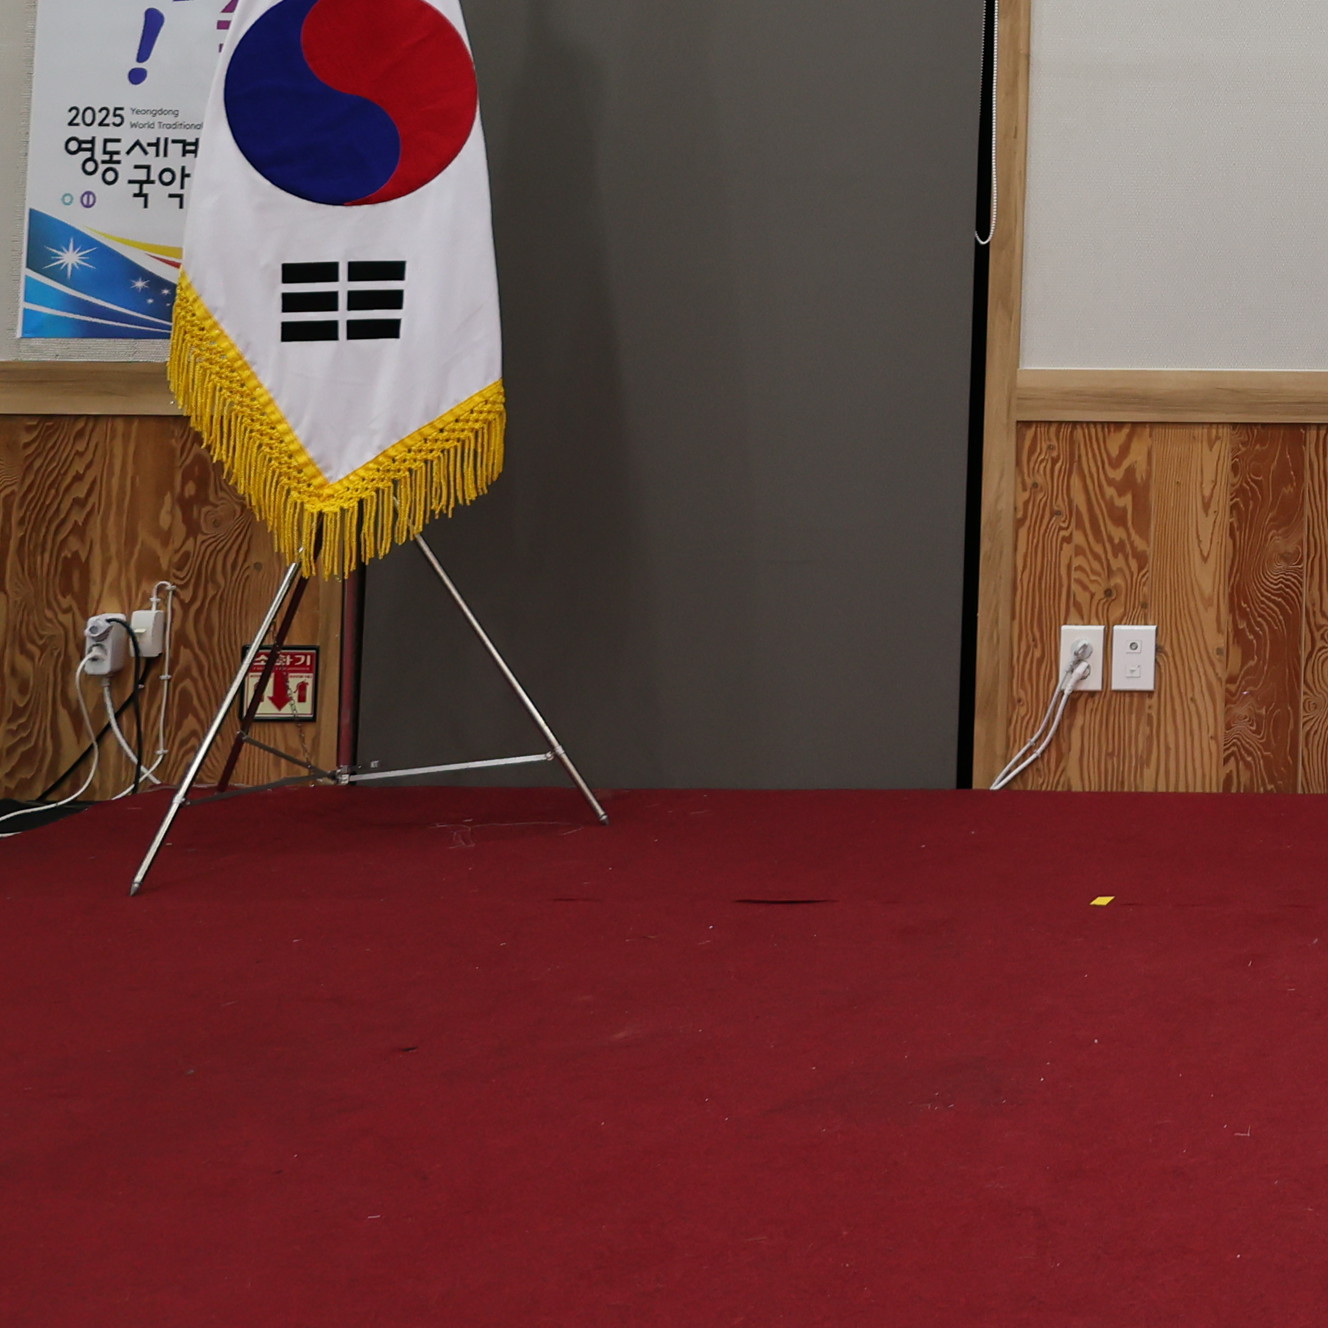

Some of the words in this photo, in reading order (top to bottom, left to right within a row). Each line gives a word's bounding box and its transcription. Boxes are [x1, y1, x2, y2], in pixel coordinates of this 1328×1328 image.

[67, 105, 125, 128] 2025
[130, 107, 179, 118] Yeongdong
[129, 121, 155, 130] World
[253, 654, 311, 666] 소화기
